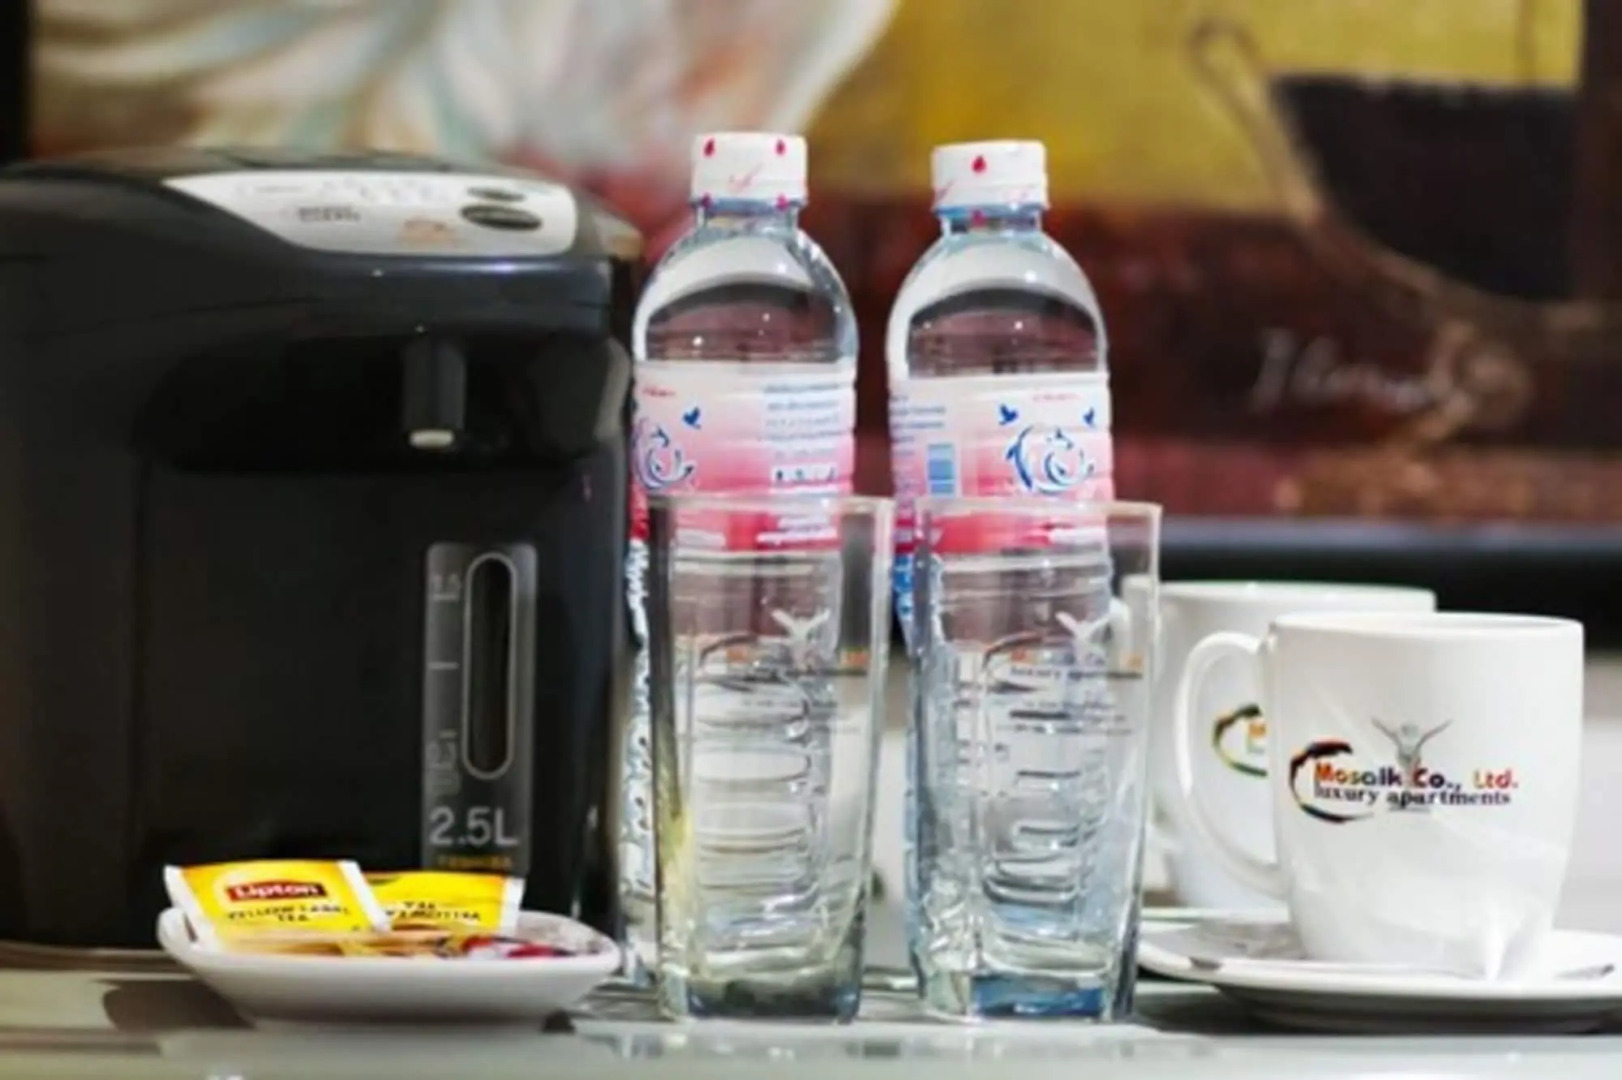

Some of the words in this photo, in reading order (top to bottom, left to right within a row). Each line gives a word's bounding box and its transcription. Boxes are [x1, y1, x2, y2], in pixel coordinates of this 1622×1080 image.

[1386, 789, 1511, 810] apartments
[429, 805, 520, 846] 2.5L
[234, 883, 320, 899] Lipton
